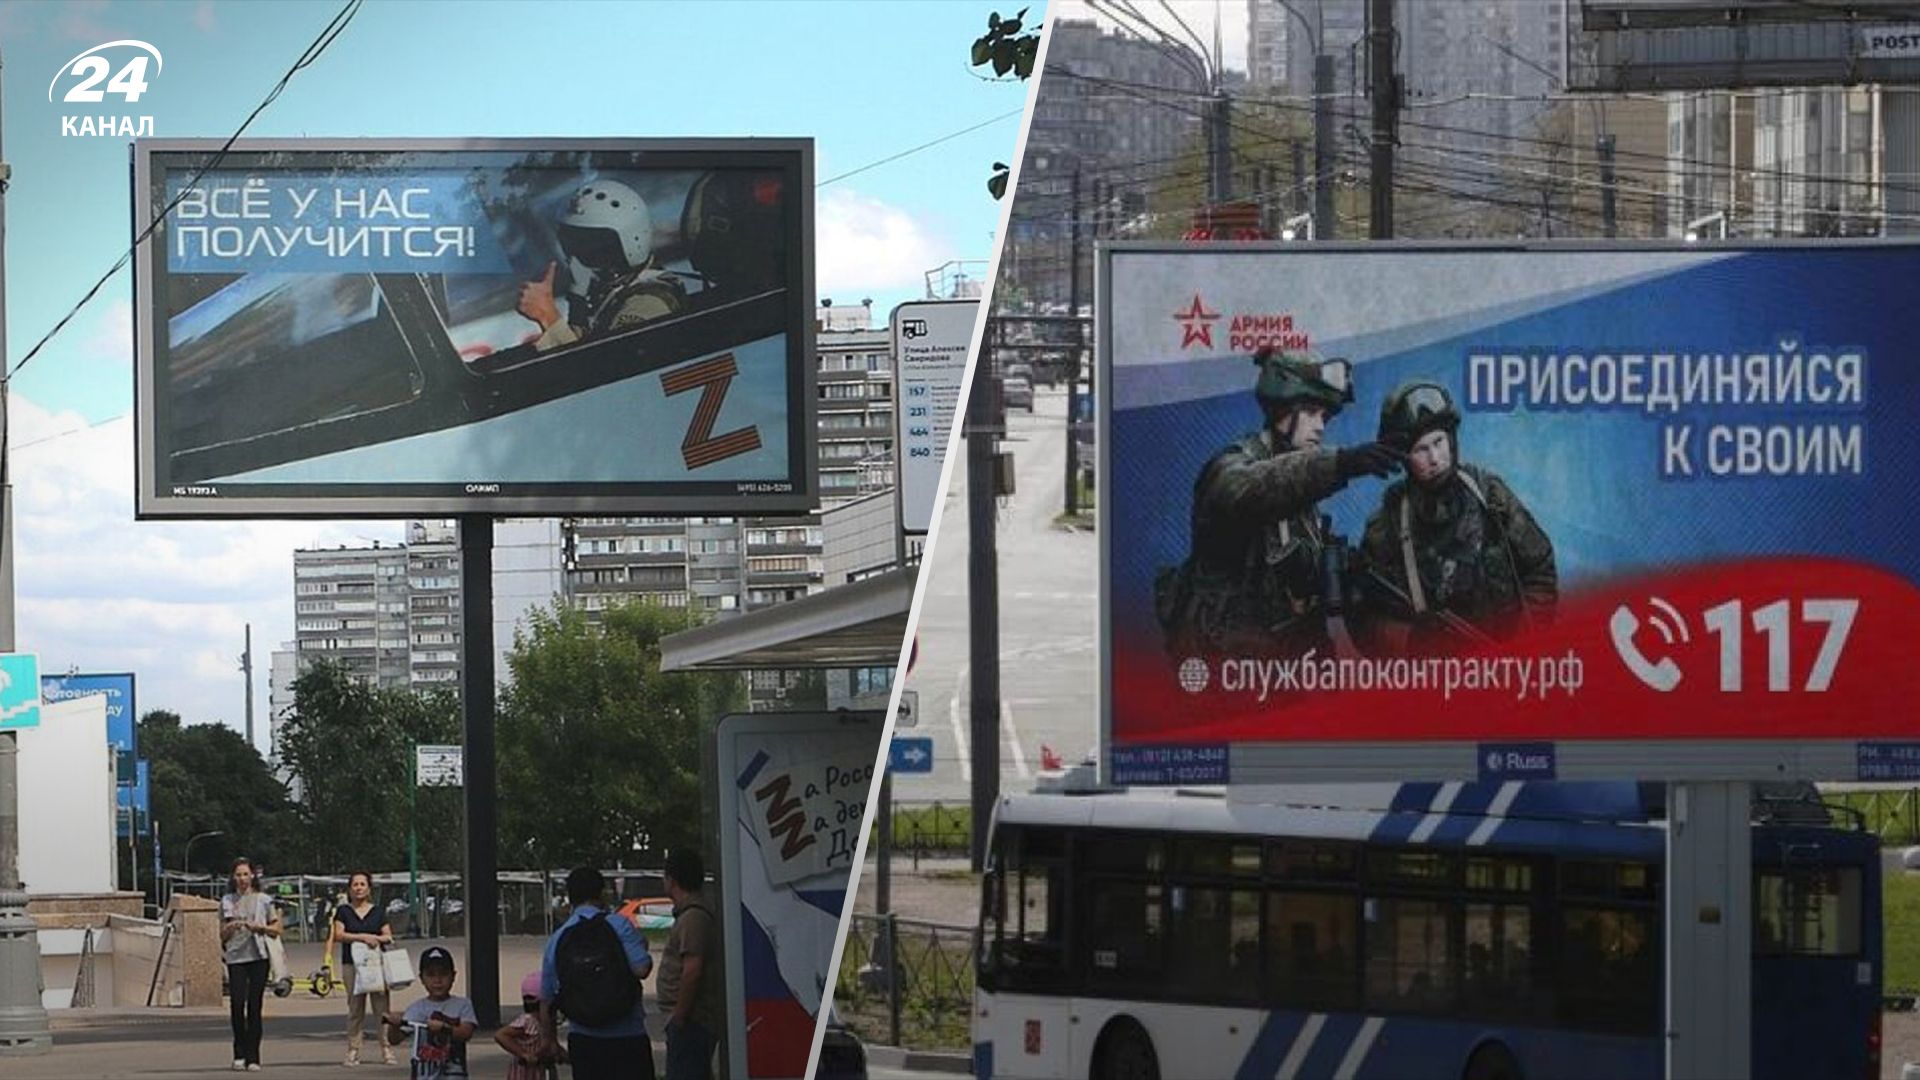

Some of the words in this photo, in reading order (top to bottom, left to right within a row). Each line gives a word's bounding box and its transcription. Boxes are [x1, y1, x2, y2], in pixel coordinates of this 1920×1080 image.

[177, 179, 271, 219] ВСЁ
[287, 188, 318, 219] У
[335, 188, 431, 219] НАС
[176, 226, 476, 257] ПОЛУЧИТСЯ!
[1229, 315, 1294, 332] АРМИЯ
[1229, 334, 1309, 352] РОССИИ
[908, 387, 926, 397] 157
[1469, 341, 1863, 413] ПРИСОЕДИНЯЙСЯ
[659, 351, 763, 472] Z
[910, 407, 927, 417] 231
[1664, 426, 1693, 475] К
[1708, 425, 1863, 475] СВОИМ
[1704, 599, 1861, 693] 117
[1221, 648, 1585, 704] службапоконтракту.рф
